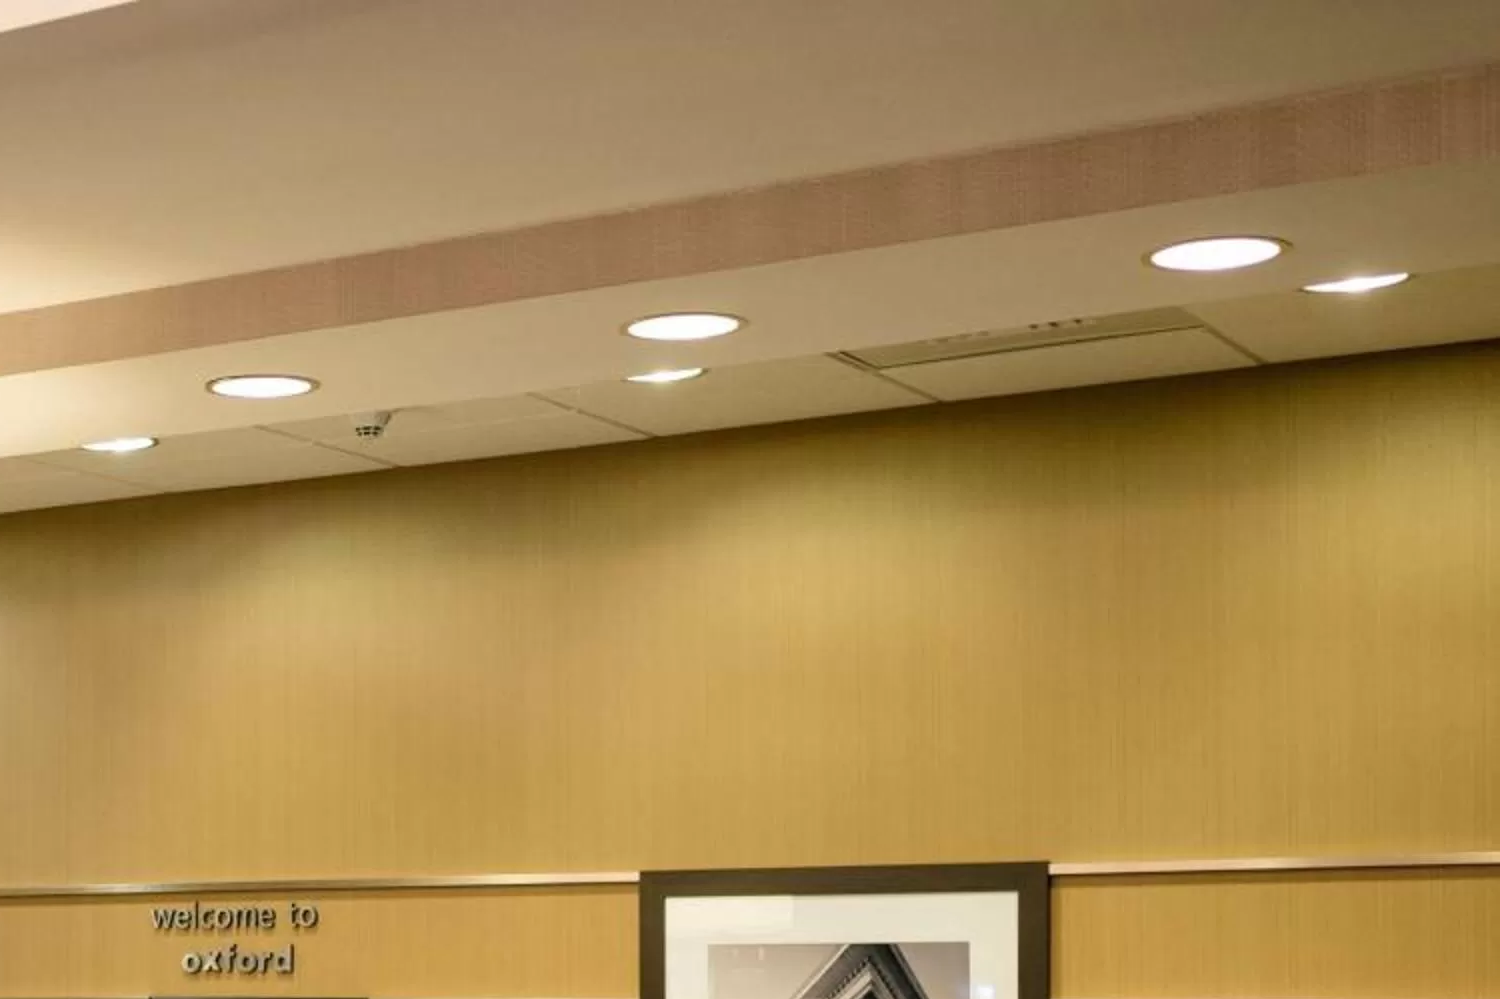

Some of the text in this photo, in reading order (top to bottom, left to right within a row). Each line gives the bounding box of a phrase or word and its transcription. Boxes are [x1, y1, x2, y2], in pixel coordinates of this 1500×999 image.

[152, 901, 318, 930] welcome to
[181, 944, 295, 974] oxford
